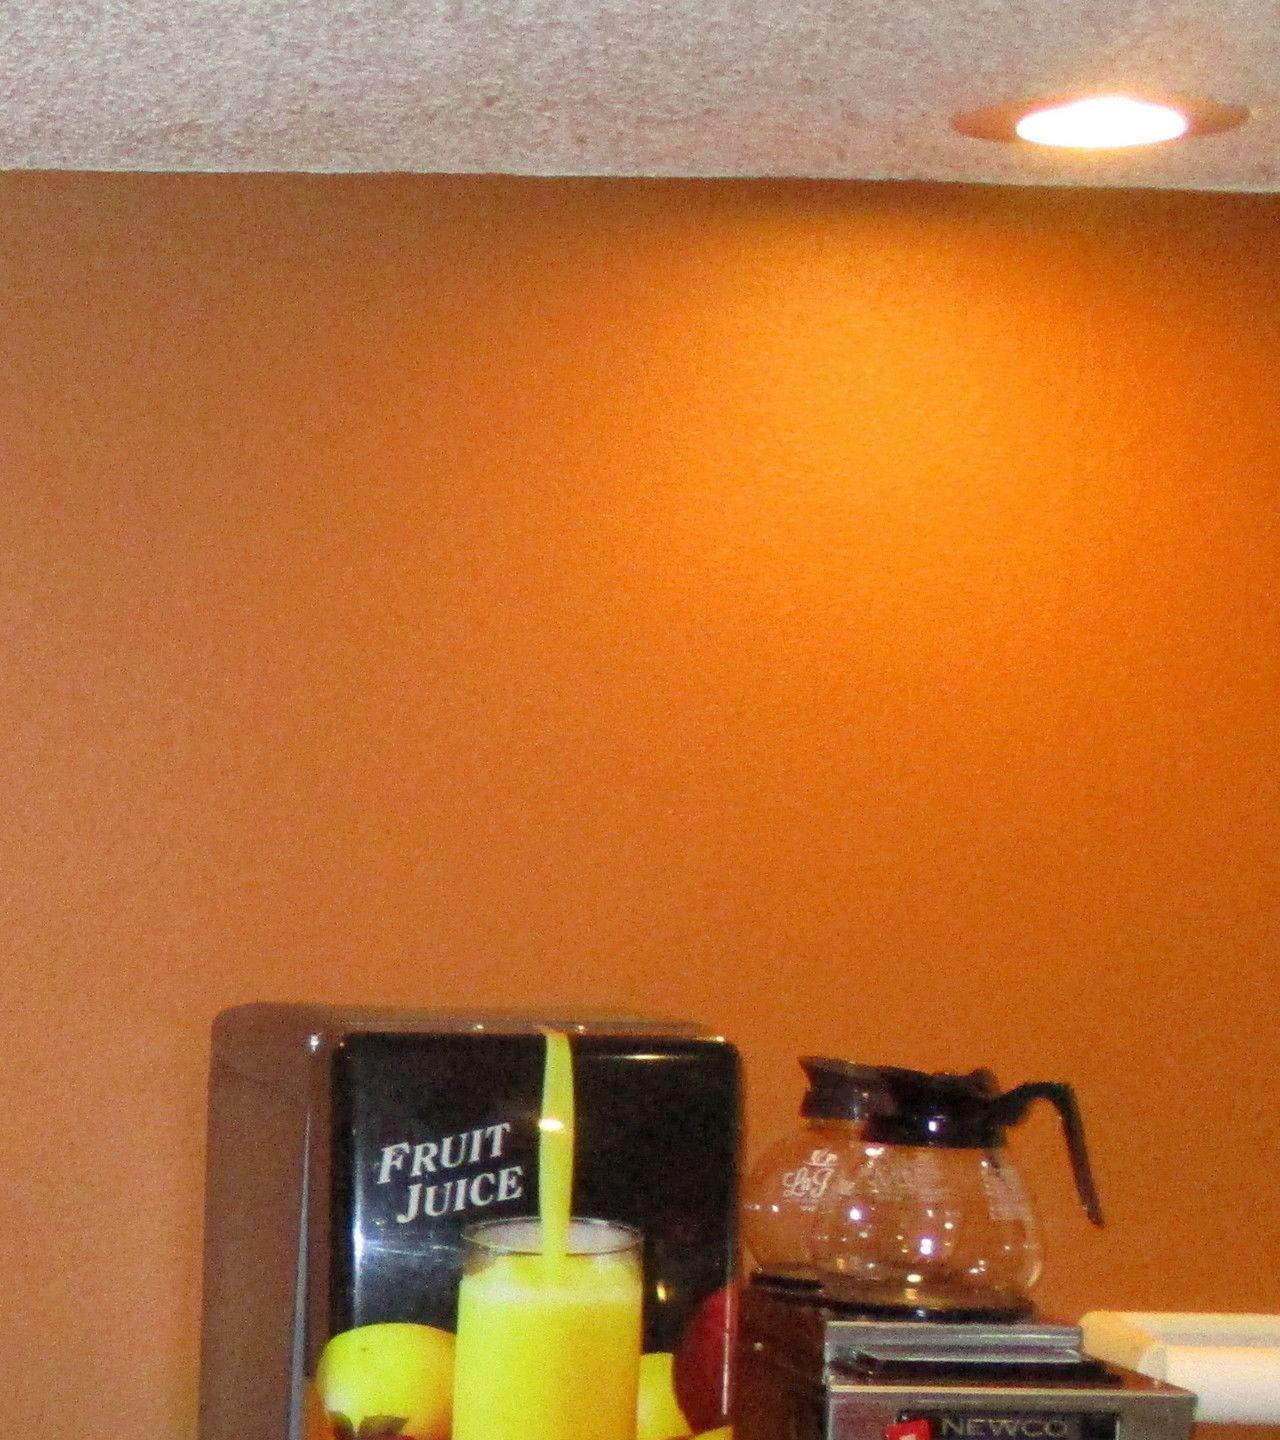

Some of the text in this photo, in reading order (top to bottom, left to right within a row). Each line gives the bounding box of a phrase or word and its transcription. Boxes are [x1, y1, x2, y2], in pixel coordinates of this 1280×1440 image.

[377, 1122, 511, 1184] FRUIT
[396, 1166, 523, 1223] JUICE
[941, 1418, 1069, 1438] NEWCO
